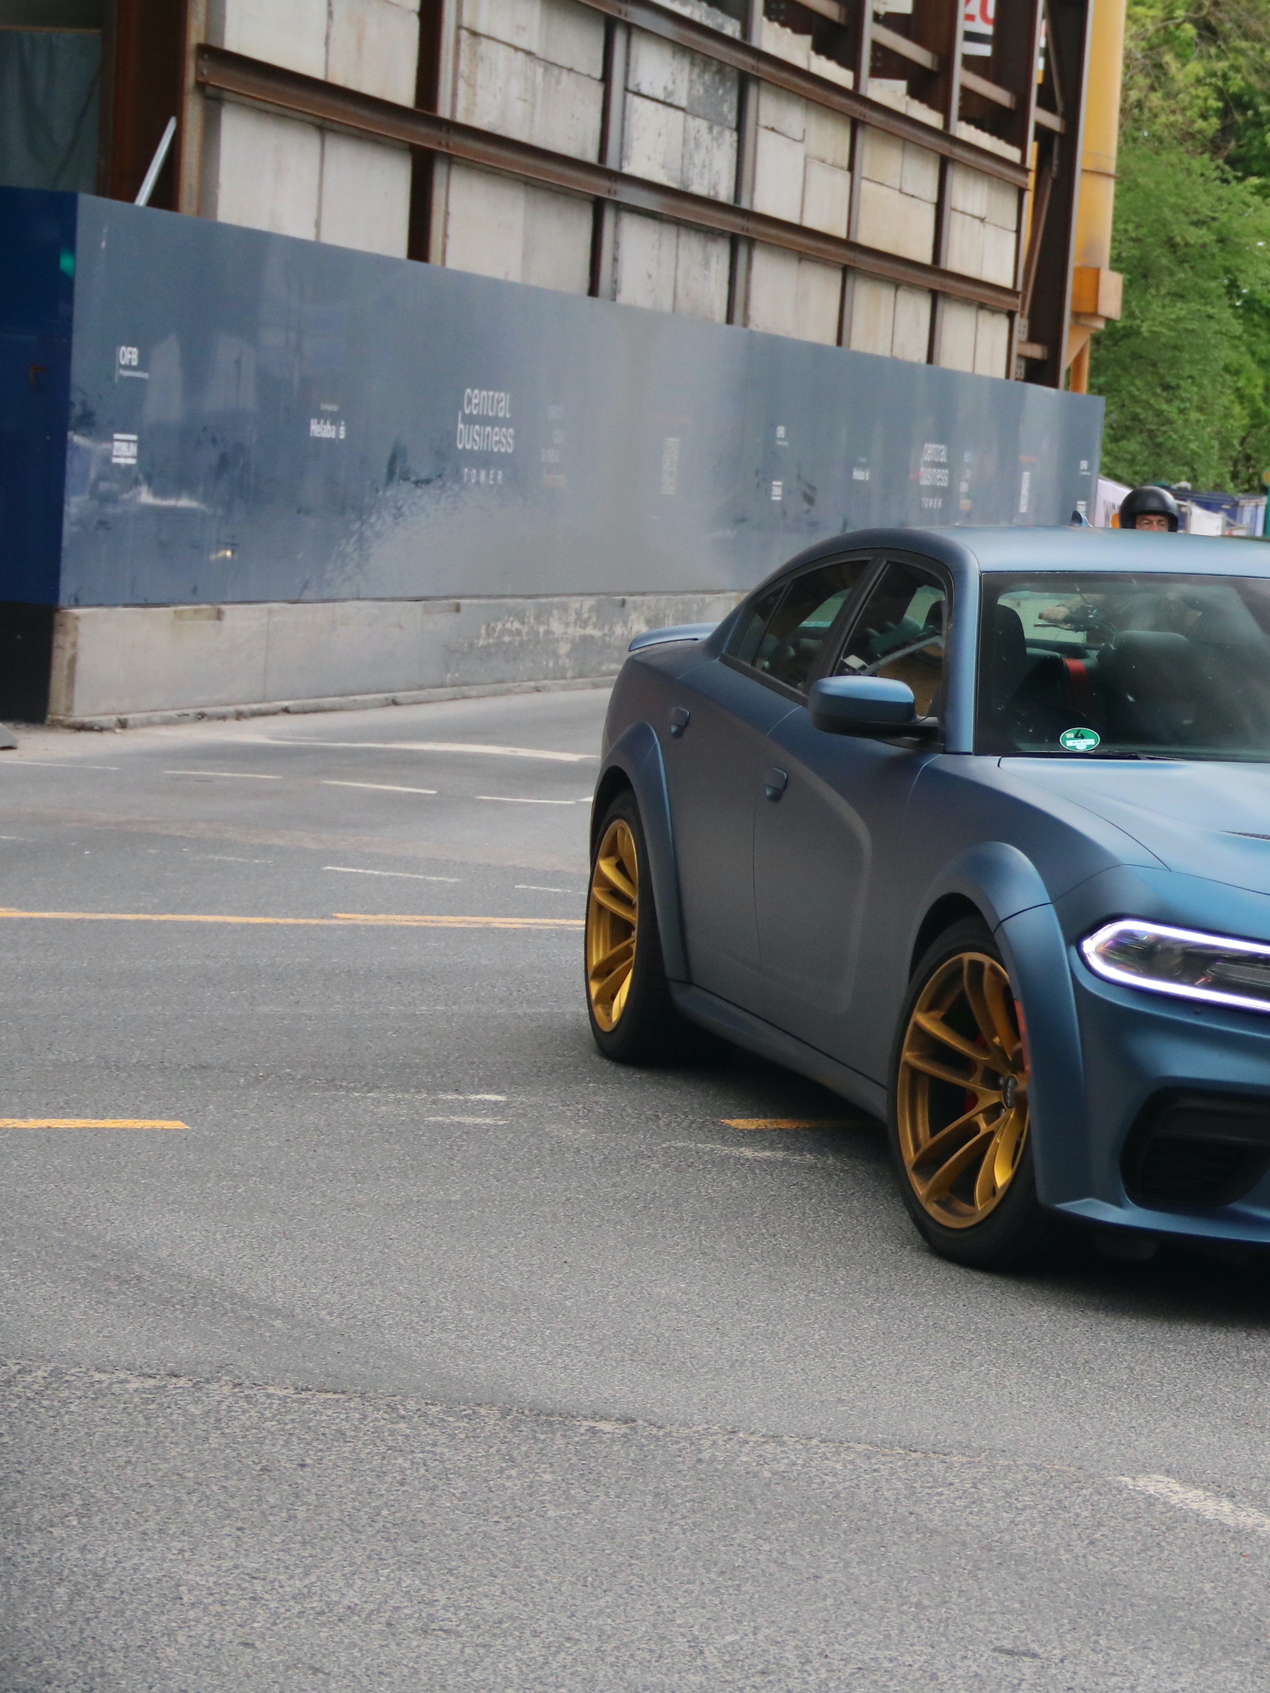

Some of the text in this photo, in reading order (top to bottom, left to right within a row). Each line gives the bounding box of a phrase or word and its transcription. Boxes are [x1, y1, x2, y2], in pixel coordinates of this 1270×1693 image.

[119, 346, 138, 366] OFB
[464, 388, 511, 418] central
[457, 411, 514, 453] business
[463, 468, 503, 484] TOWER
